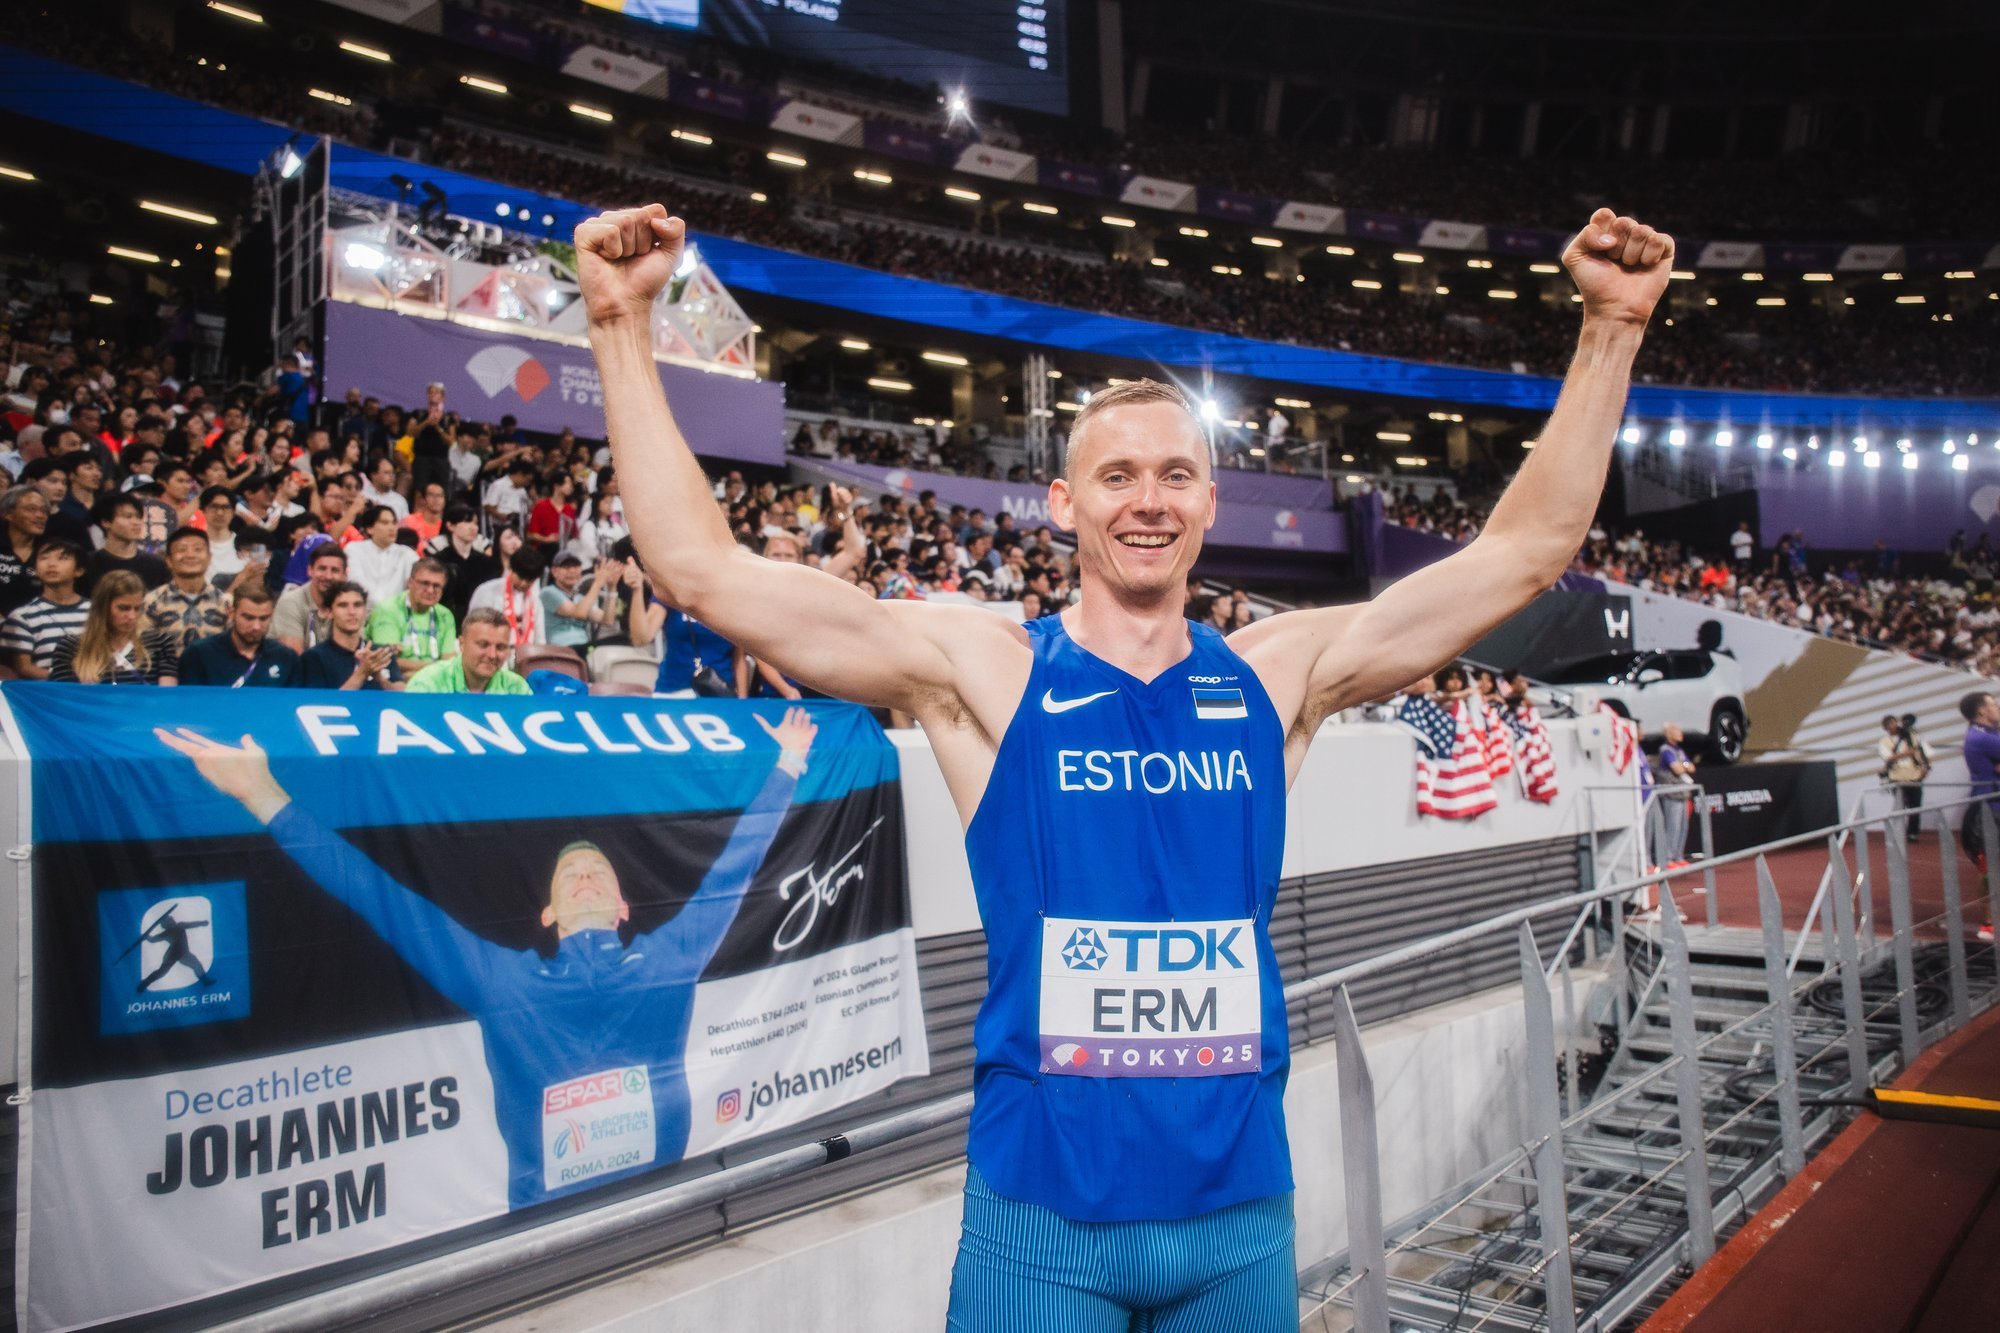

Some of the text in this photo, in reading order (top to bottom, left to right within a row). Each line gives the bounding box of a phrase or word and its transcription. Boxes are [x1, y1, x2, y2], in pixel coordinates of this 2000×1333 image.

[1188, 675, 1221, 684] coop
[296, 705, 746, 755] FANCLUB
[1058, 749, 1253, 794] ESTONIA
[1108, 926, 1245, 972] TDK
[126, 991, 232, 1015] JOHANNES ERM
[1093, 987, 1217, 1033] ERM
[707, 1016, 760, 1036] Decathlon
[710, 1036, 766, 1057] Heptathlon
[1098, 1044, 1253, 1067] TOKYO 25
[165, 1064, 352, 1121] Decathlete
[547, 1074, 621, 1113] SPAR
[146, 1076, 460, 1195] JOHANNES
[590, 1110, 648, 1132] EUROPEAN
[590, 1121, 649, 1142] ATHLETICS
[561, 1150, 640, 1181] ROMA 2024
[261, 1162, 386, 1249] ERM
